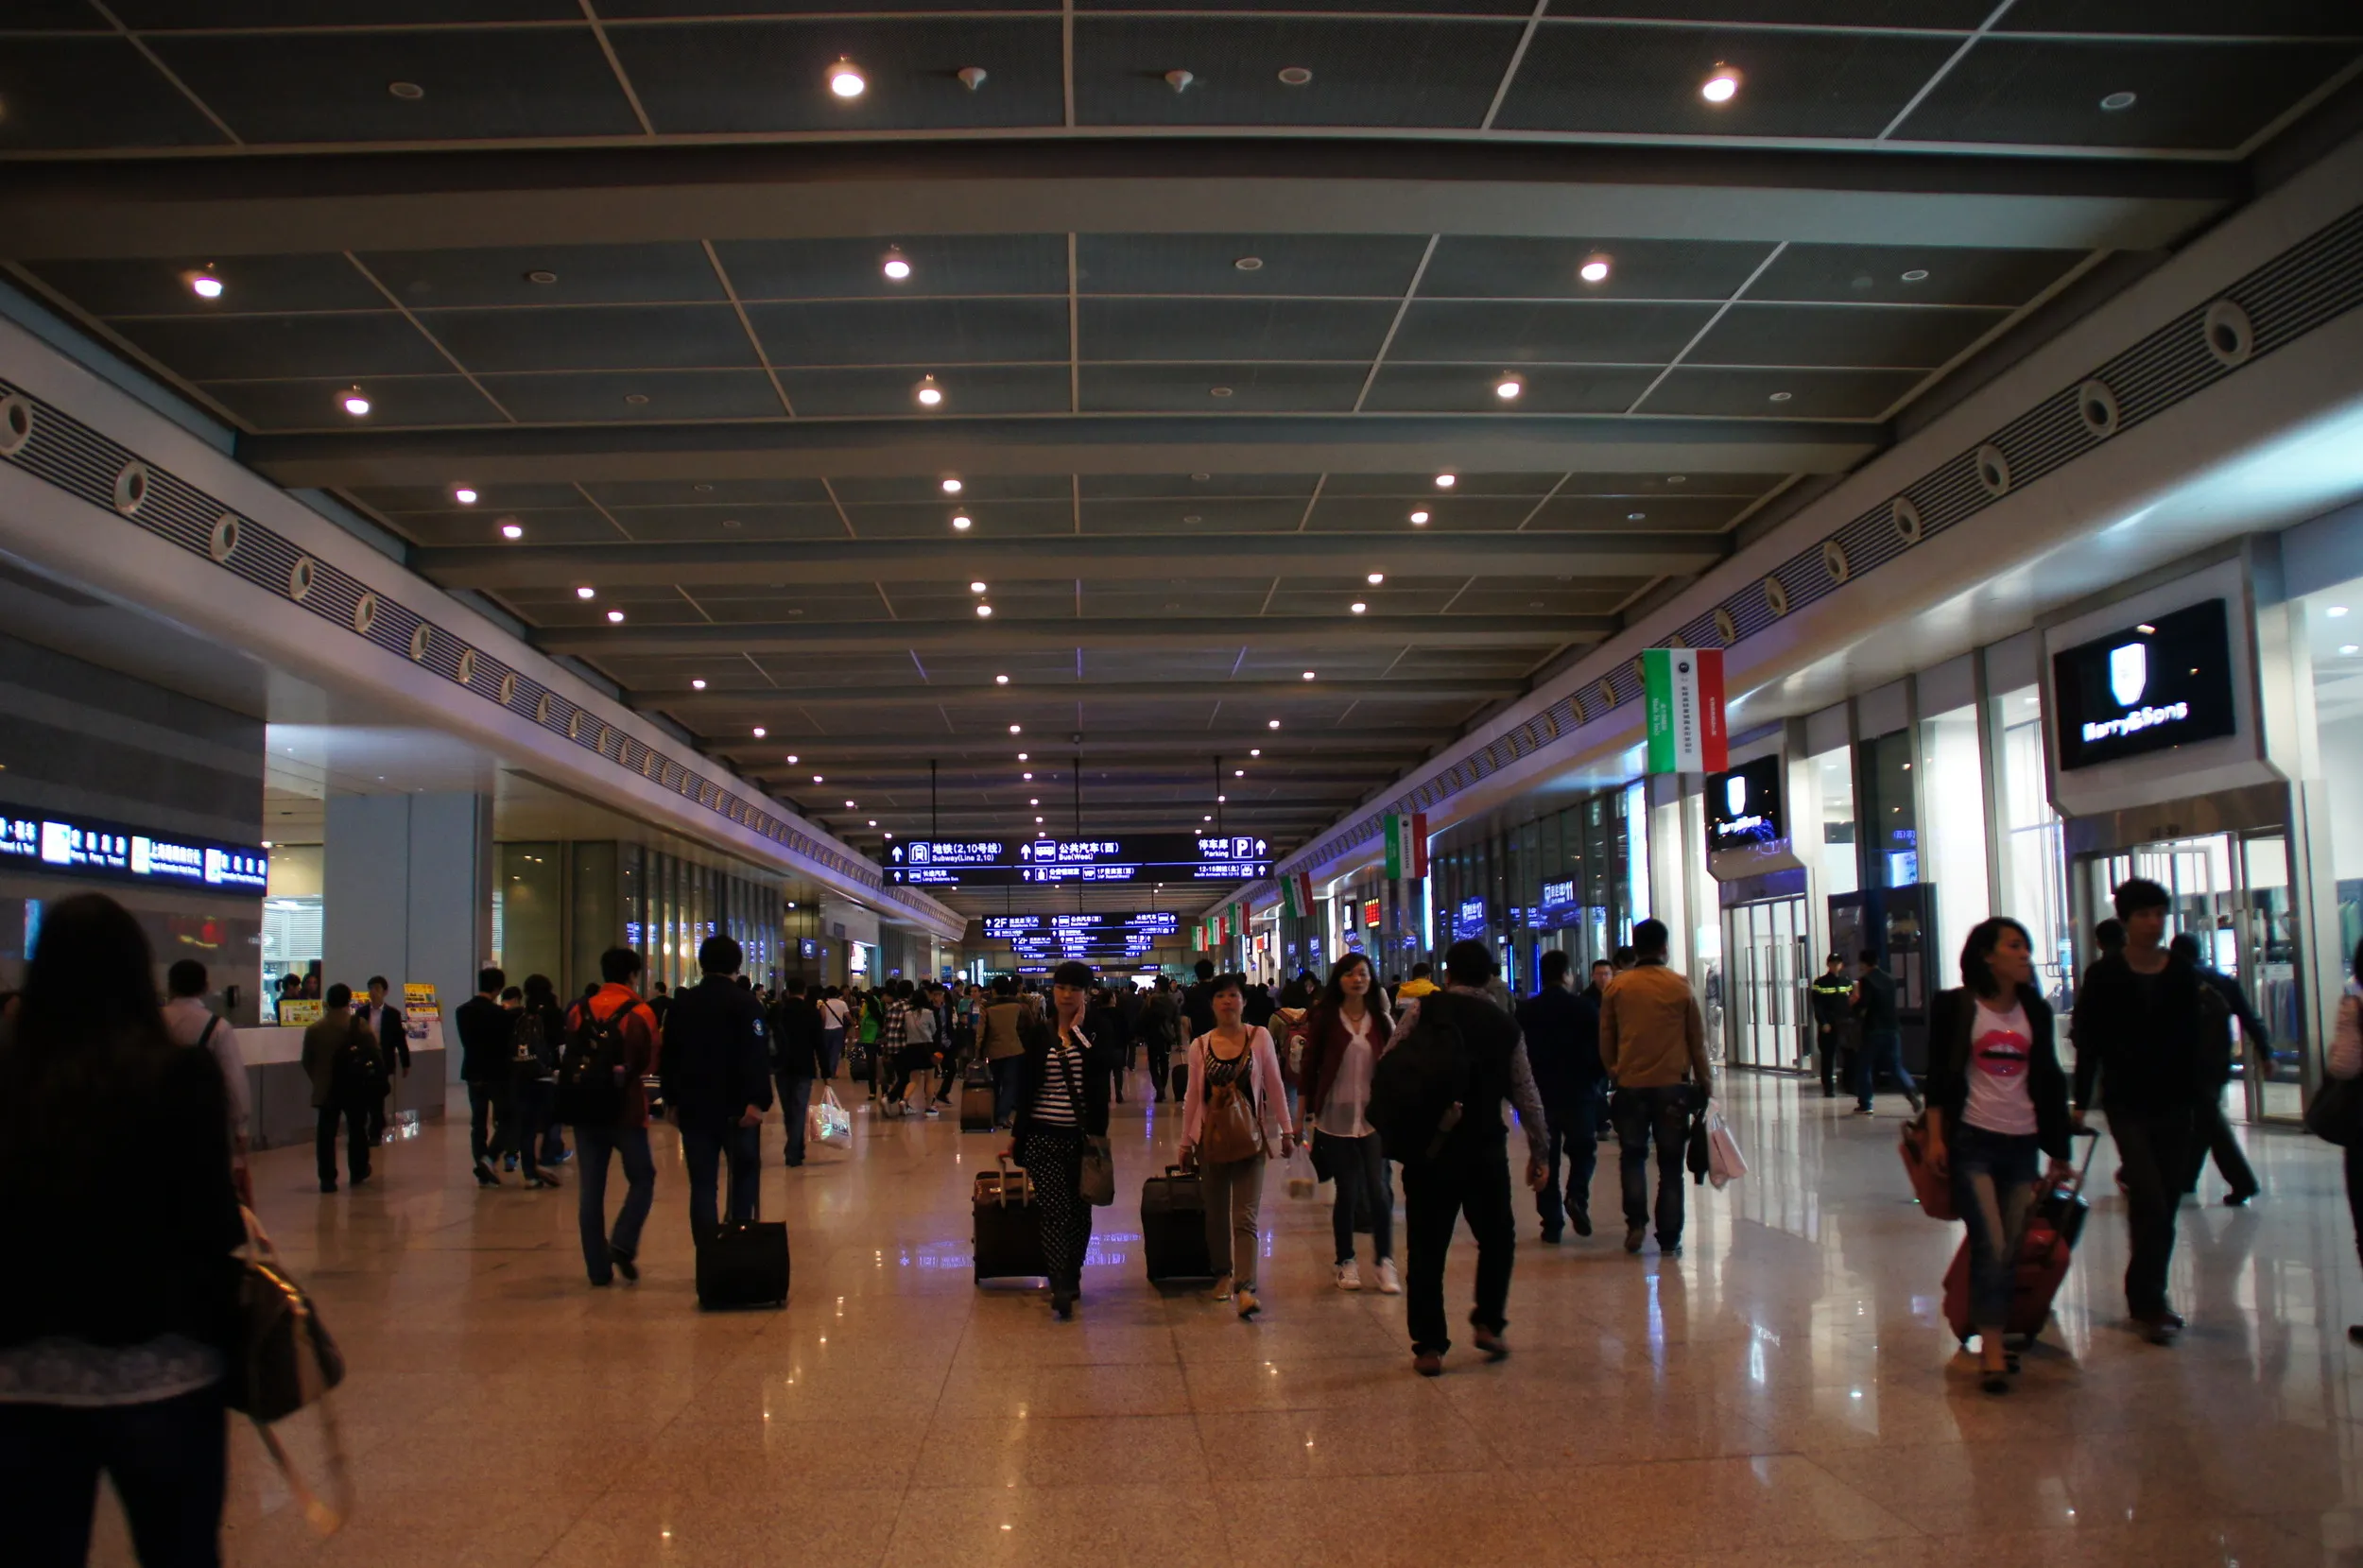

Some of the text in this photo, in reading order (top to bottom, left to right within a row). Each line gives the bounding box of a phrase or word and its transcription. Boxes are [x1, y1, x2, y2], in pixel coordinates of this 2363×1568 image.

[932, 842, 1002, 854] 地铁(2,10号线)
[1059, 842, 1119, 853] 公共汽车(西)
[1198, 838, 1229, 850] 停车库
[932, 853, 994, 863] Subway(Line 2,10)
[993, 918, 1008, 928] 2F
